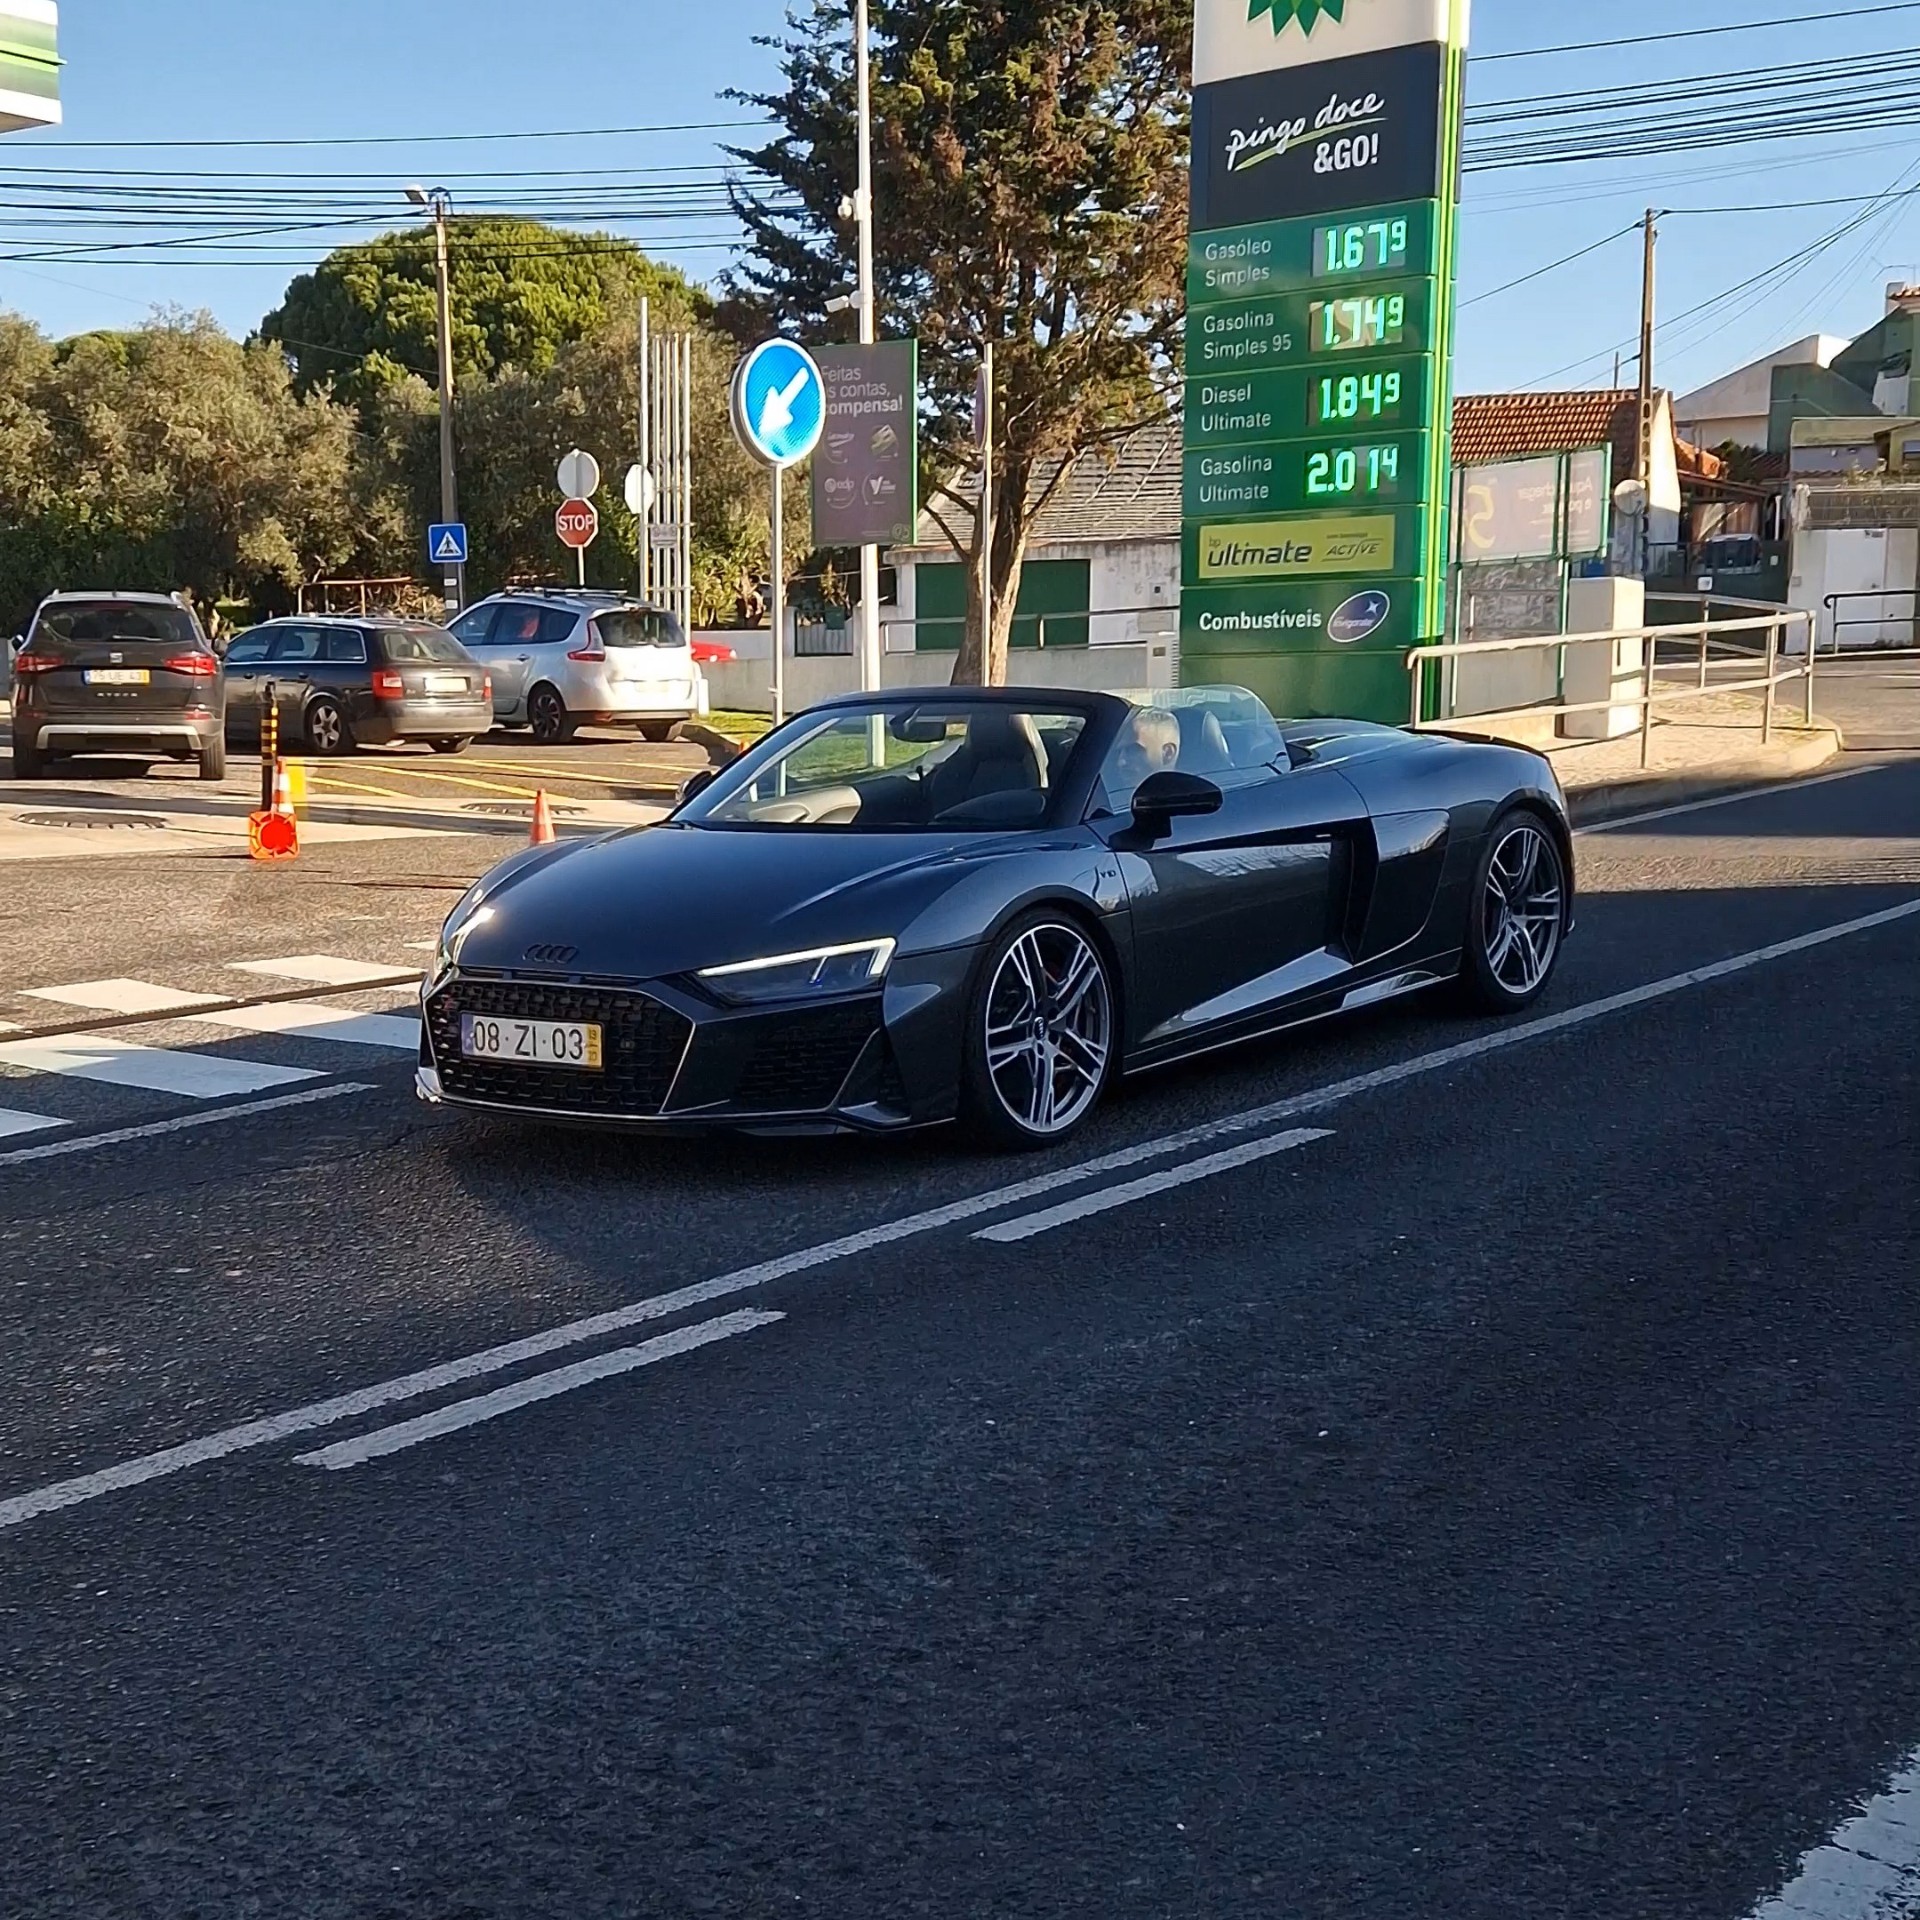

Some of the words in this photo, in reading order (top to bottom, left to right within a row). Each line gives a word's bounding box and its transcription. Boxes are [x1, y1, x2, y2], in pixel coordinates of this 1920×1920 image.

[1225, 117, 1306, 172] pingo
[1314, 92, 1386, 129] doce
[1313, 133, 1380, 174] &GO!
[1205, 237, 1272, 261] Gasóleo
[1205, 266, 1270, 288] Simples
[1203, 311, 1275, 334] Gasolina
[1203, 336, 1268, 361] Simples
[1272, 334, 1292, 352] 95
[826, 394, 903, 418] ompensa!
[1201, 384, 1251, 405] Diesel
[1201, 413, 1272, 432] Ultimate
[1200, 456, 1272, 476] Gasolina
[1199, 484, 1269, 503] Ultimate
[558, 515, 594, 532] STOP
[1207, 539, 1313, 567] ultimate
[1199, 608, 1322, 632] Combustíveis
